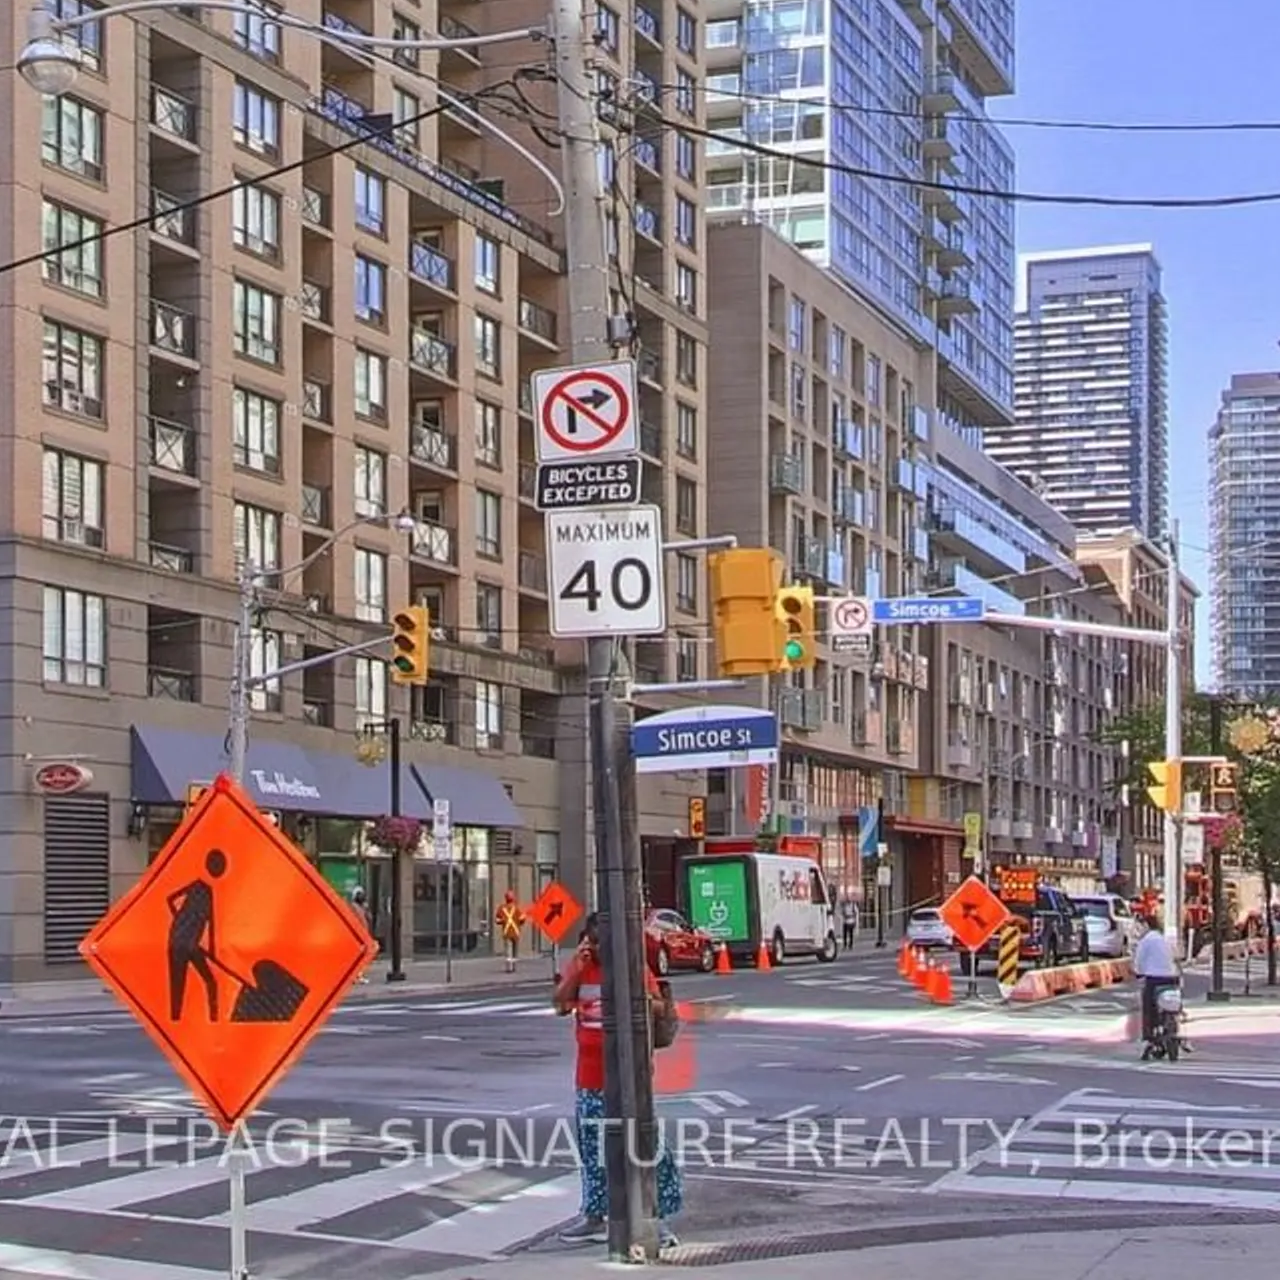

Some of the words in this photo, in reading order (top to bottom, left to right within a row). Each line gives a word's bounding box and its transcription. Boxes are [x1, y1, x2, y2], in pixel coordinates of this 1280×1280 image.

[548, 465, 628, 484] BICYCLES
[543, 483, 632, 503] EXCEPTED
[556, 522, 650, 542] MAXIMUM
[560, 558, 651, 611] 40
[889, 601, 951, 617] Simcoe
[658, 729, 731, 751] Simcoe
[736, 728, 751, 744] St
